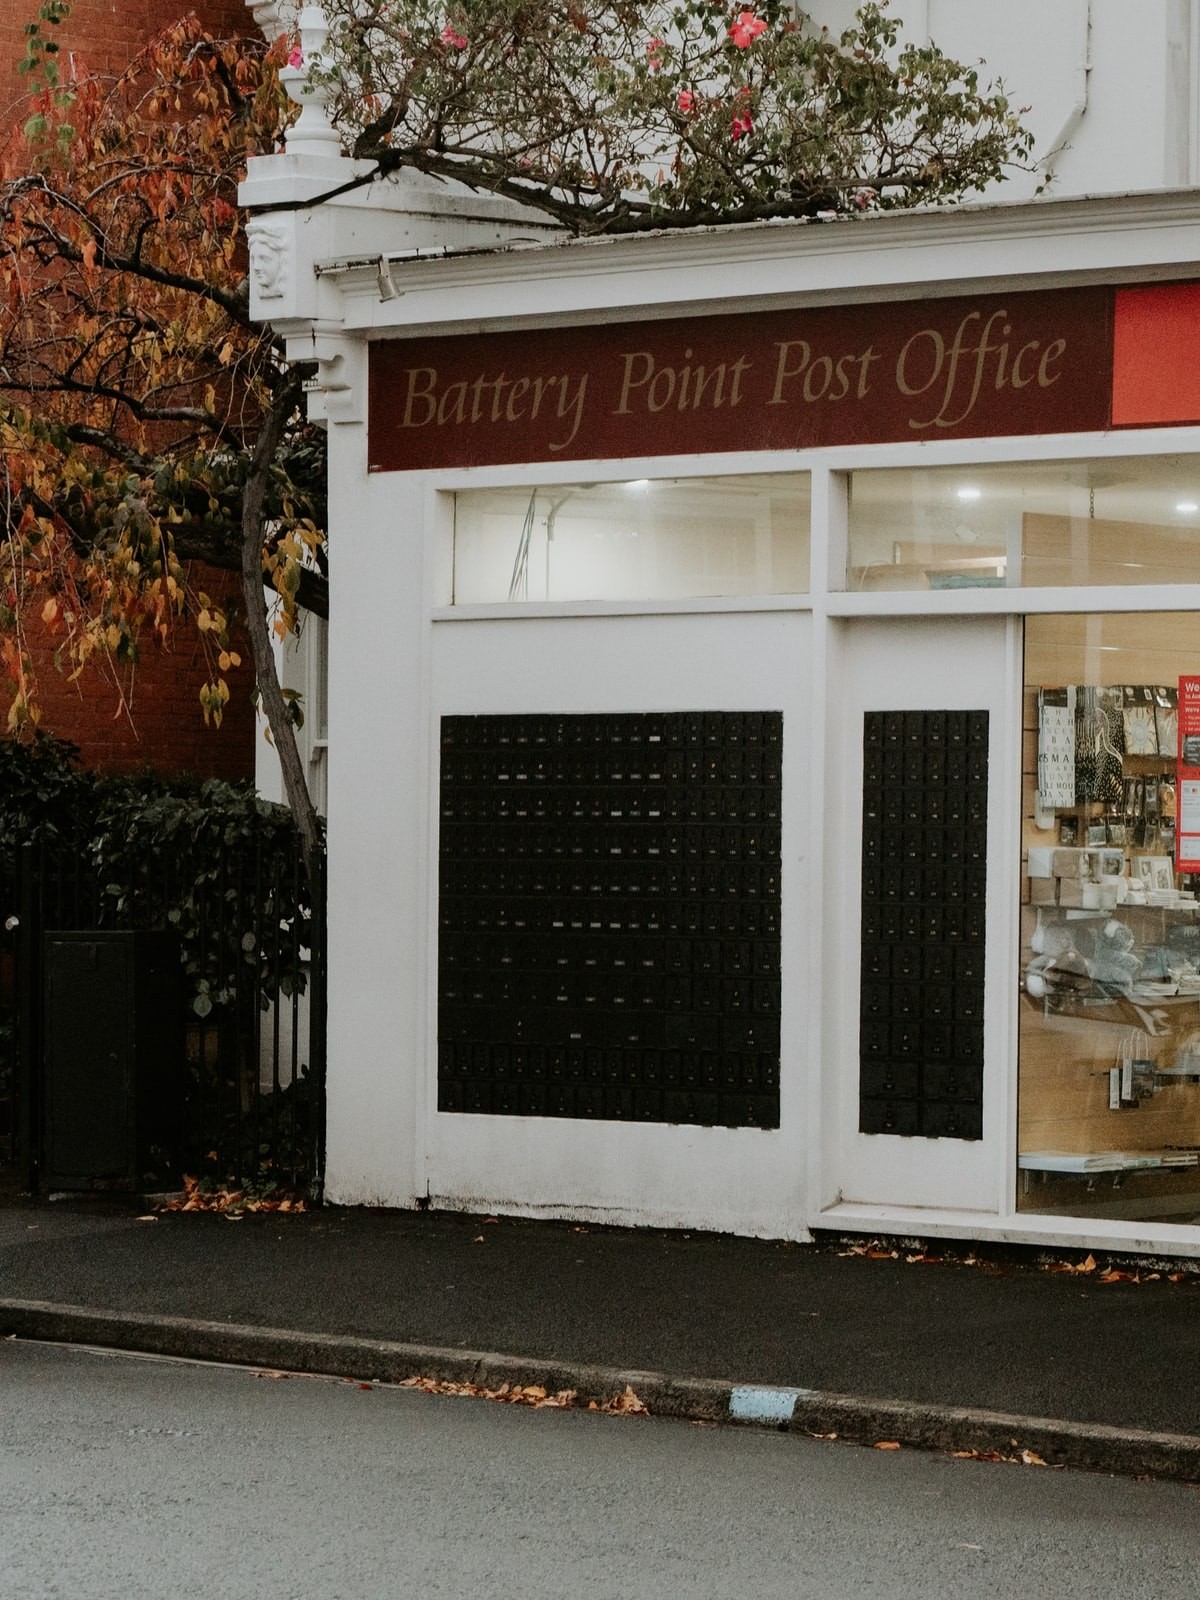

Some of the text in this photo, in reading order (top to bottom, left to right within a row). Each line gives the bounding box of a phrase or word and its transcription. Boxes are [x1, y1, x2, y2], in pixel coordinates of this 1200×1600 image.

[398, 309, 1068, 452] Battery Point Post Office
